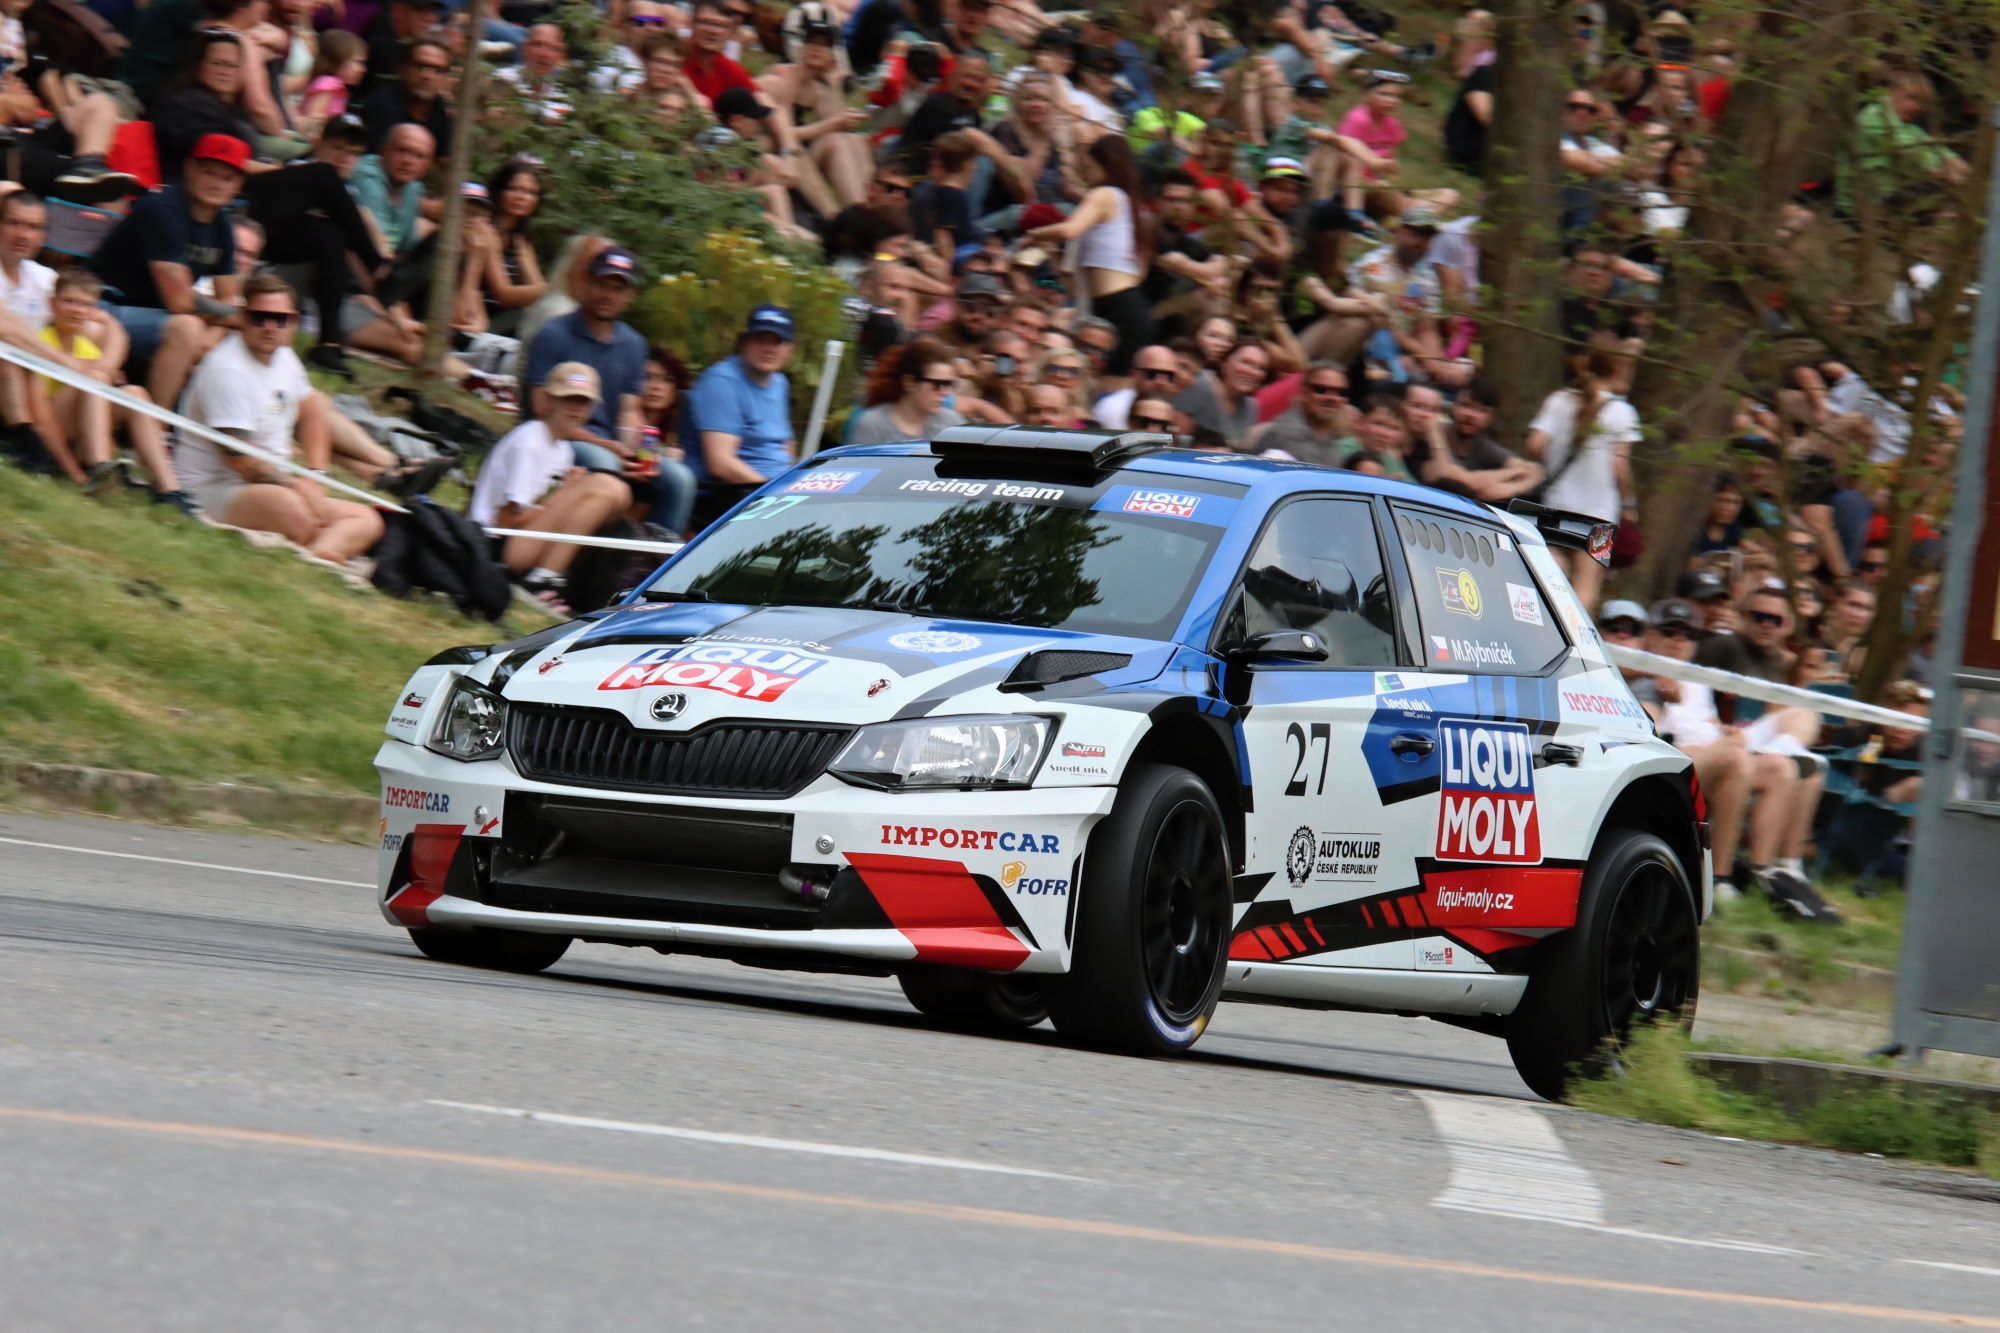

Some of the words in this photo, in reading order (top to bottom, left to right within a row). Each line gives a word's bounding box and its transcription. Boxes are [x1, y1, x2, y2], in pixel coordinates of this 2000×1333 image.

[788, 481, 848, 491] MOLY
[802, 471, 861, 481] LIQUI
[898, 479, 988, 496] racing
[992, 482, 1065, 500] team
[1133, 491, 1196, 506] LIQUI
[730, 495, 811, 521] 27
[1127, 501, 1193, 515] MOLY
[1464, 582, 1475, 605] 3
[638, 648, 819, 675] LIQUI
[1451, 639, 1516, 668] M.Rybníček
[607, 662, 799, 697] MOLY
[1563, 692, 1645, 720] IMPORTCAR
[1284, 722, 1331, 797] 27
[1443, 726, 1529, 791] LIQUI
[386, 787, 449, 812] IMPORTCAR
[1441, 796, 1535, 856] MOLY
[383, 834, 402, 850] FOFR
[880, 824, 1060, 854] IMPORTCAR
[1318, 840, 1381, 859] AUTOKLUB
[1316, 860, 1339, 874] ČESKÉ
[1340, 863, 1378, 875] REPUBLIKY
[1016, 877, 1068, 896] FOFR
[1436, 886, 1515, 914] liqui-moly.cz
